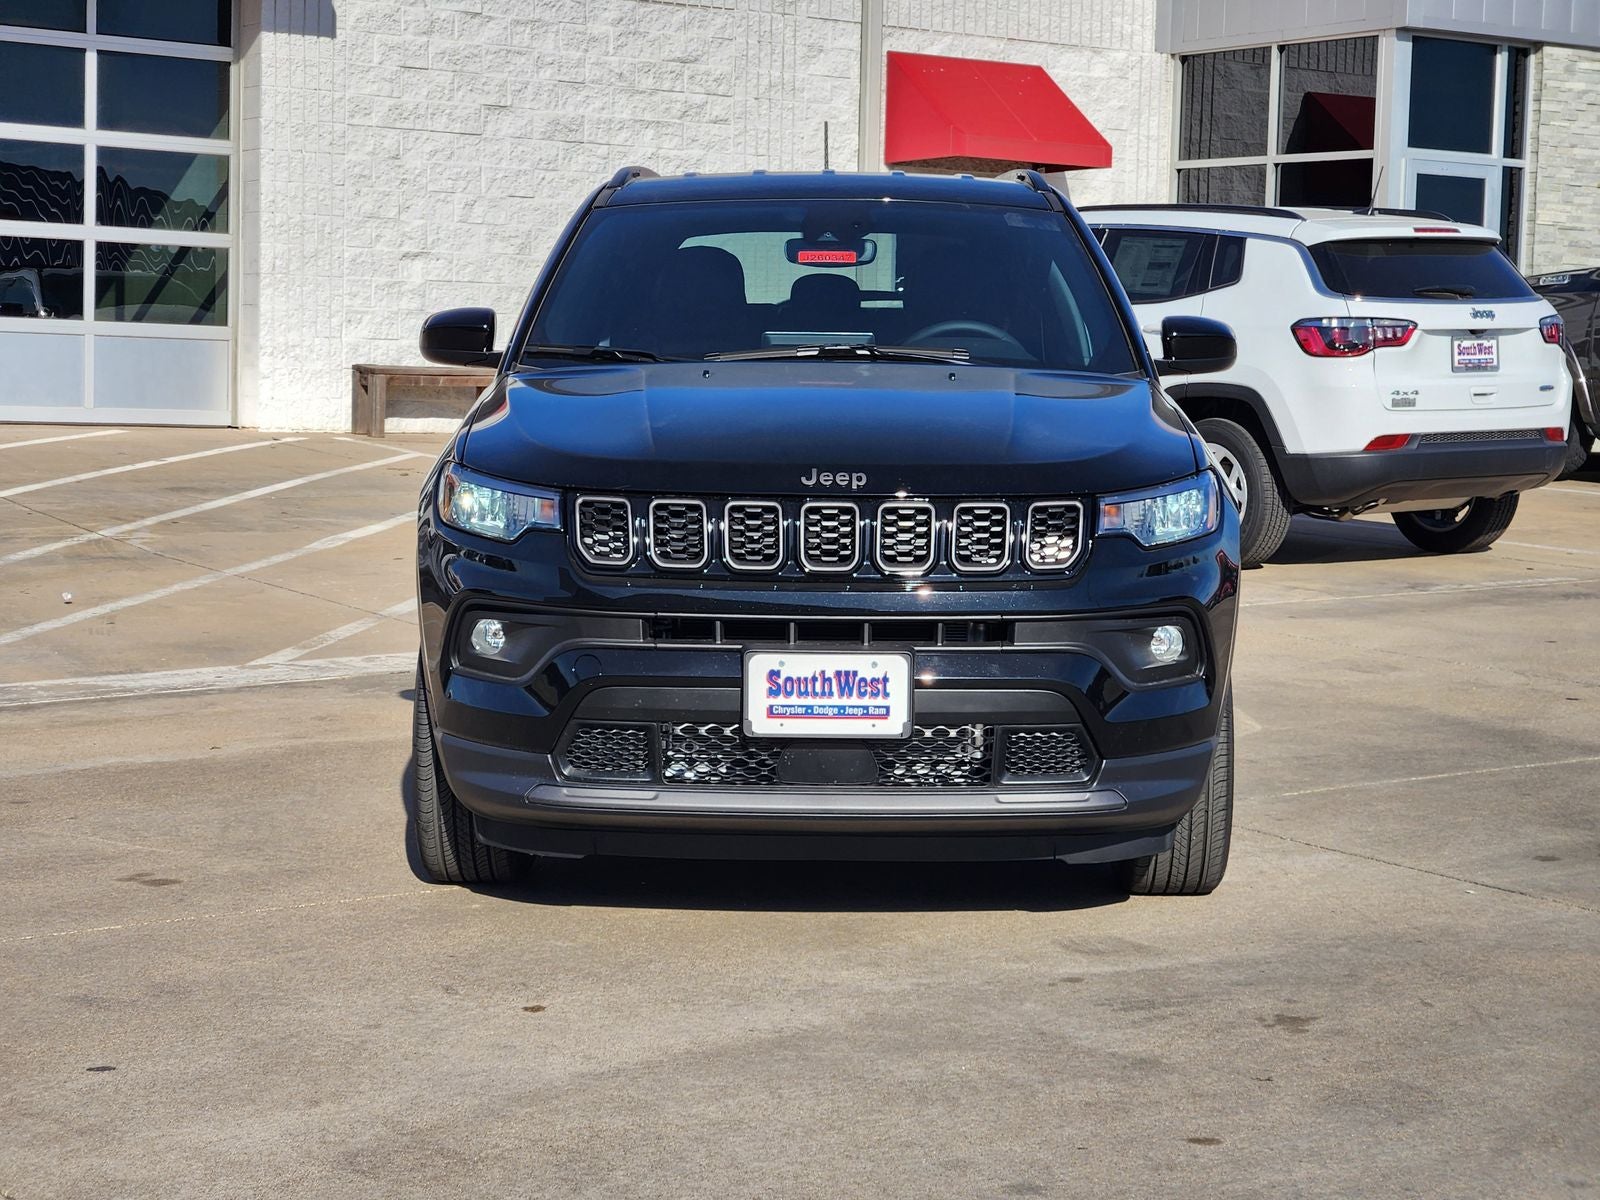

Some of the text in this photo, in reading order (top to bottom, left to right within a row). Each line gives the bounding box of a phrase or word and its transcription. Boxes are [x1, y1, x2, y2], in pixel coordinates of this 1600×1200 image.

[1470, 307, 1496, 321] Jeep
[1457, 343, 1494, 356] SouthWest
[800, 467, 867, 489] Jeep
[766, 669, 891, 699] SouthWest
[772, 705, 886, 716] Chrysler Dodge Jeep Ram
